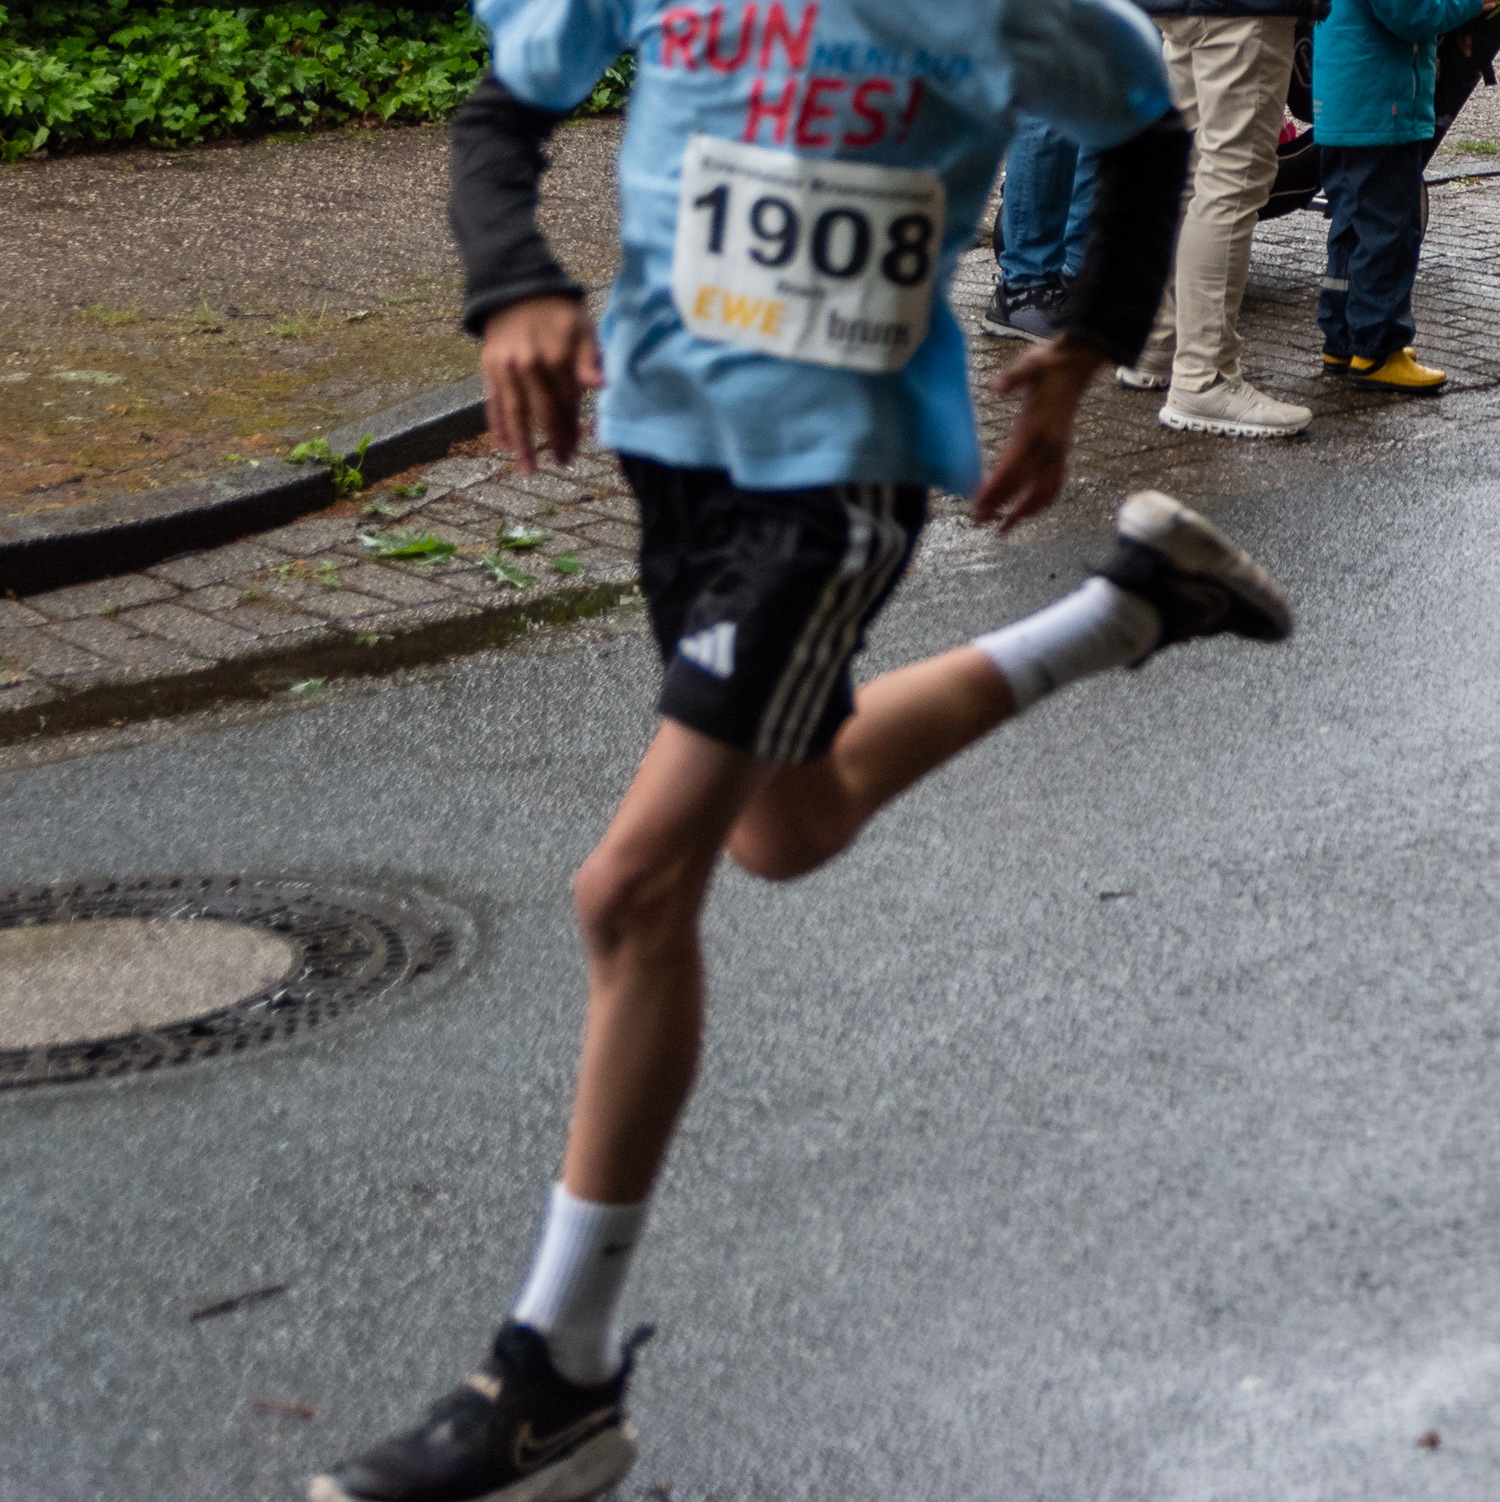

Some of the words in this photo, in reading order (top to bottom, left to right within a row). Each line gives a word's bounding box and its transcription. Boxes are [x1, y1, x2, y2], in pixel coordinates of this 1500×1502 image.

[661, 0, 819, 75] RUN
[742, 76, 924, 148] HES!
[694, 184, 933, 287] 1908
[694, 285, 788, 336] EWE
